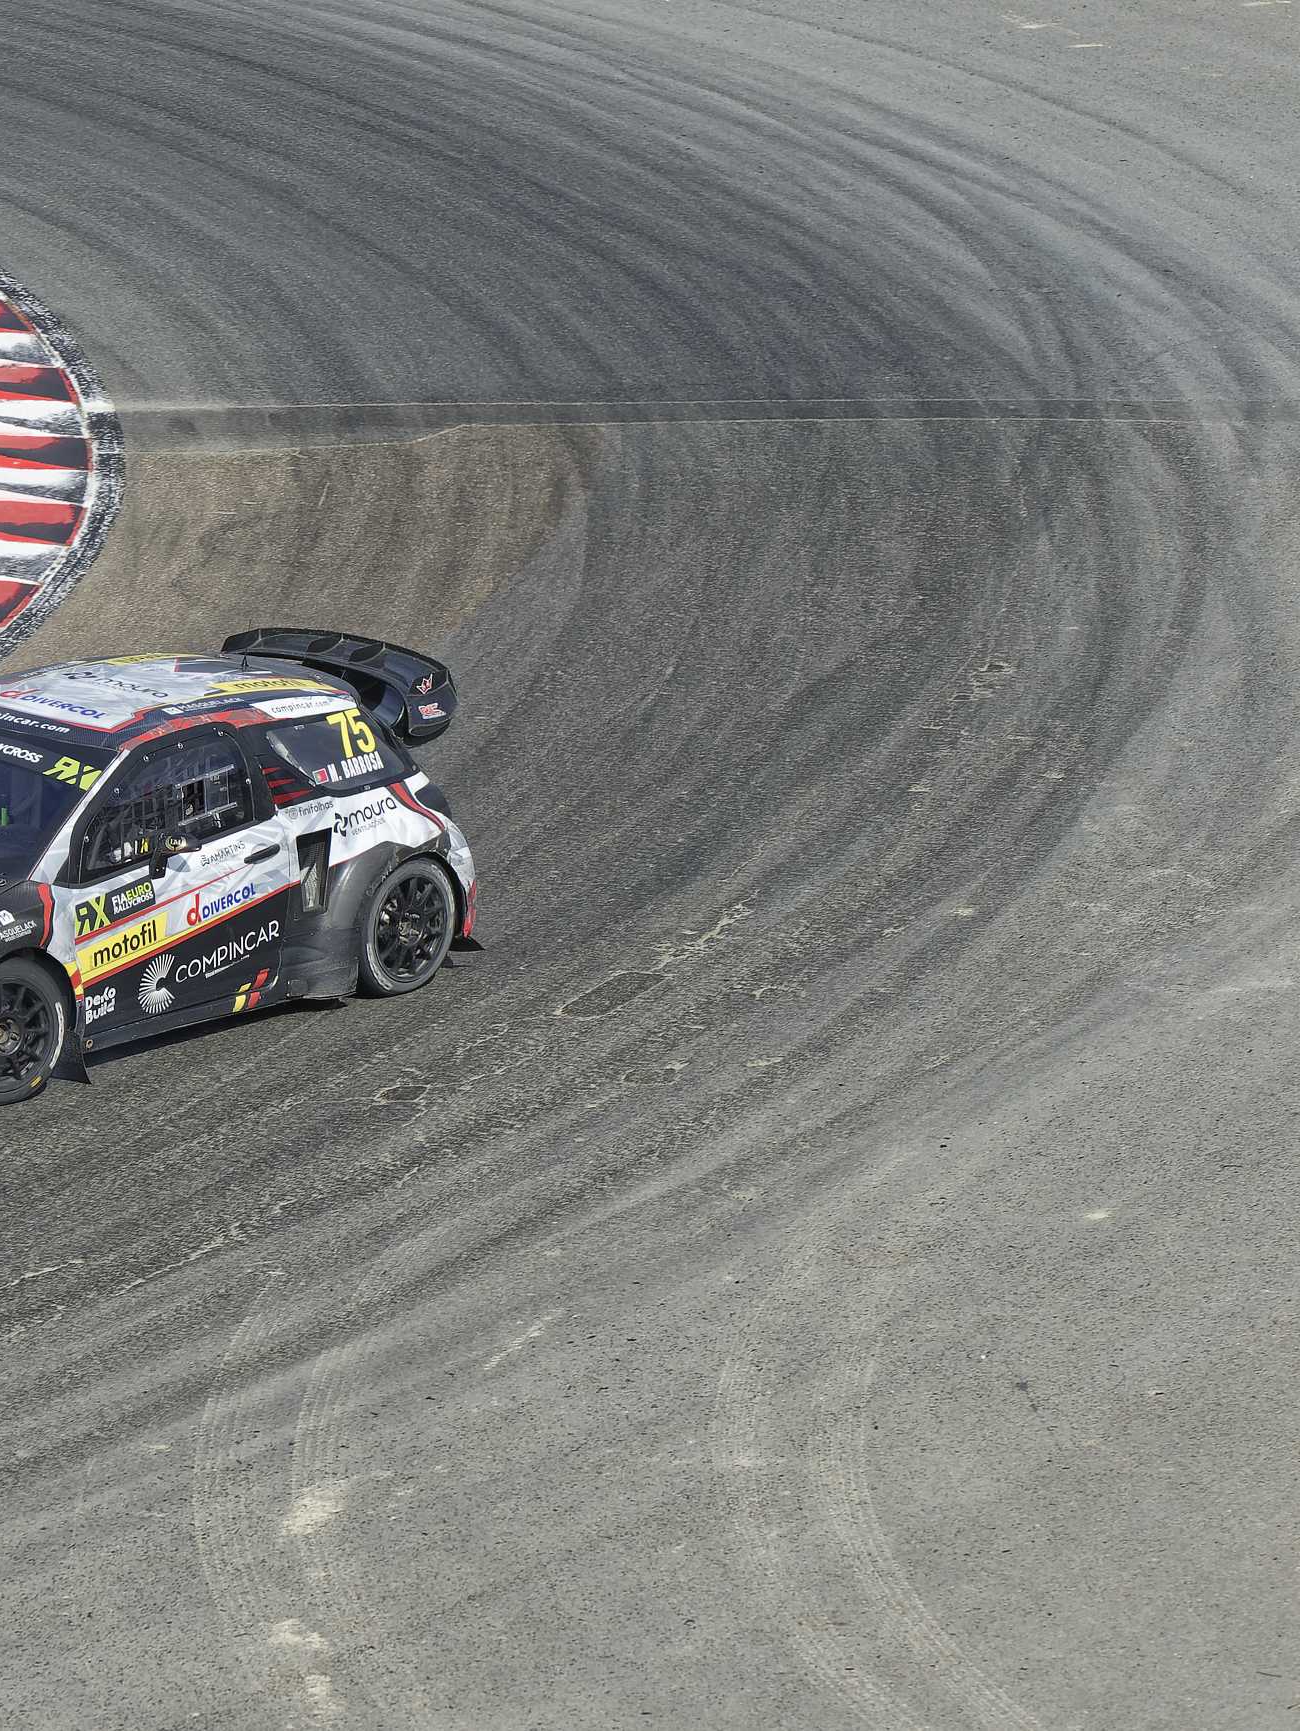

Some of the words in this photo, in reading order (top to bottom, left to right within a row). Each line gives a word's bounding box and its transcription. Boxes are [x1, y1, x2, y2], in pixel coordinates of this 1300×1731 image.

[19, 694, 108, 720] DIVERCOL
[326, 707, 376, 759] 75
[327, 763, 342, 782] M.
[341, 751, 384, 779] BARBOSA
[348, 797, 397, 829] moura
[111, 892, 127, 907] FIA
[126, 882, 152, 900] EURO
[113, 891, 154, 915] RALLYCROSS
[202, 882, 256, 919] DIVERCOL
[93, 919, 157, 967] motofil
[175, 920, 280, 983] COMPINCAR
[85, 998, 115, 1025] Build
